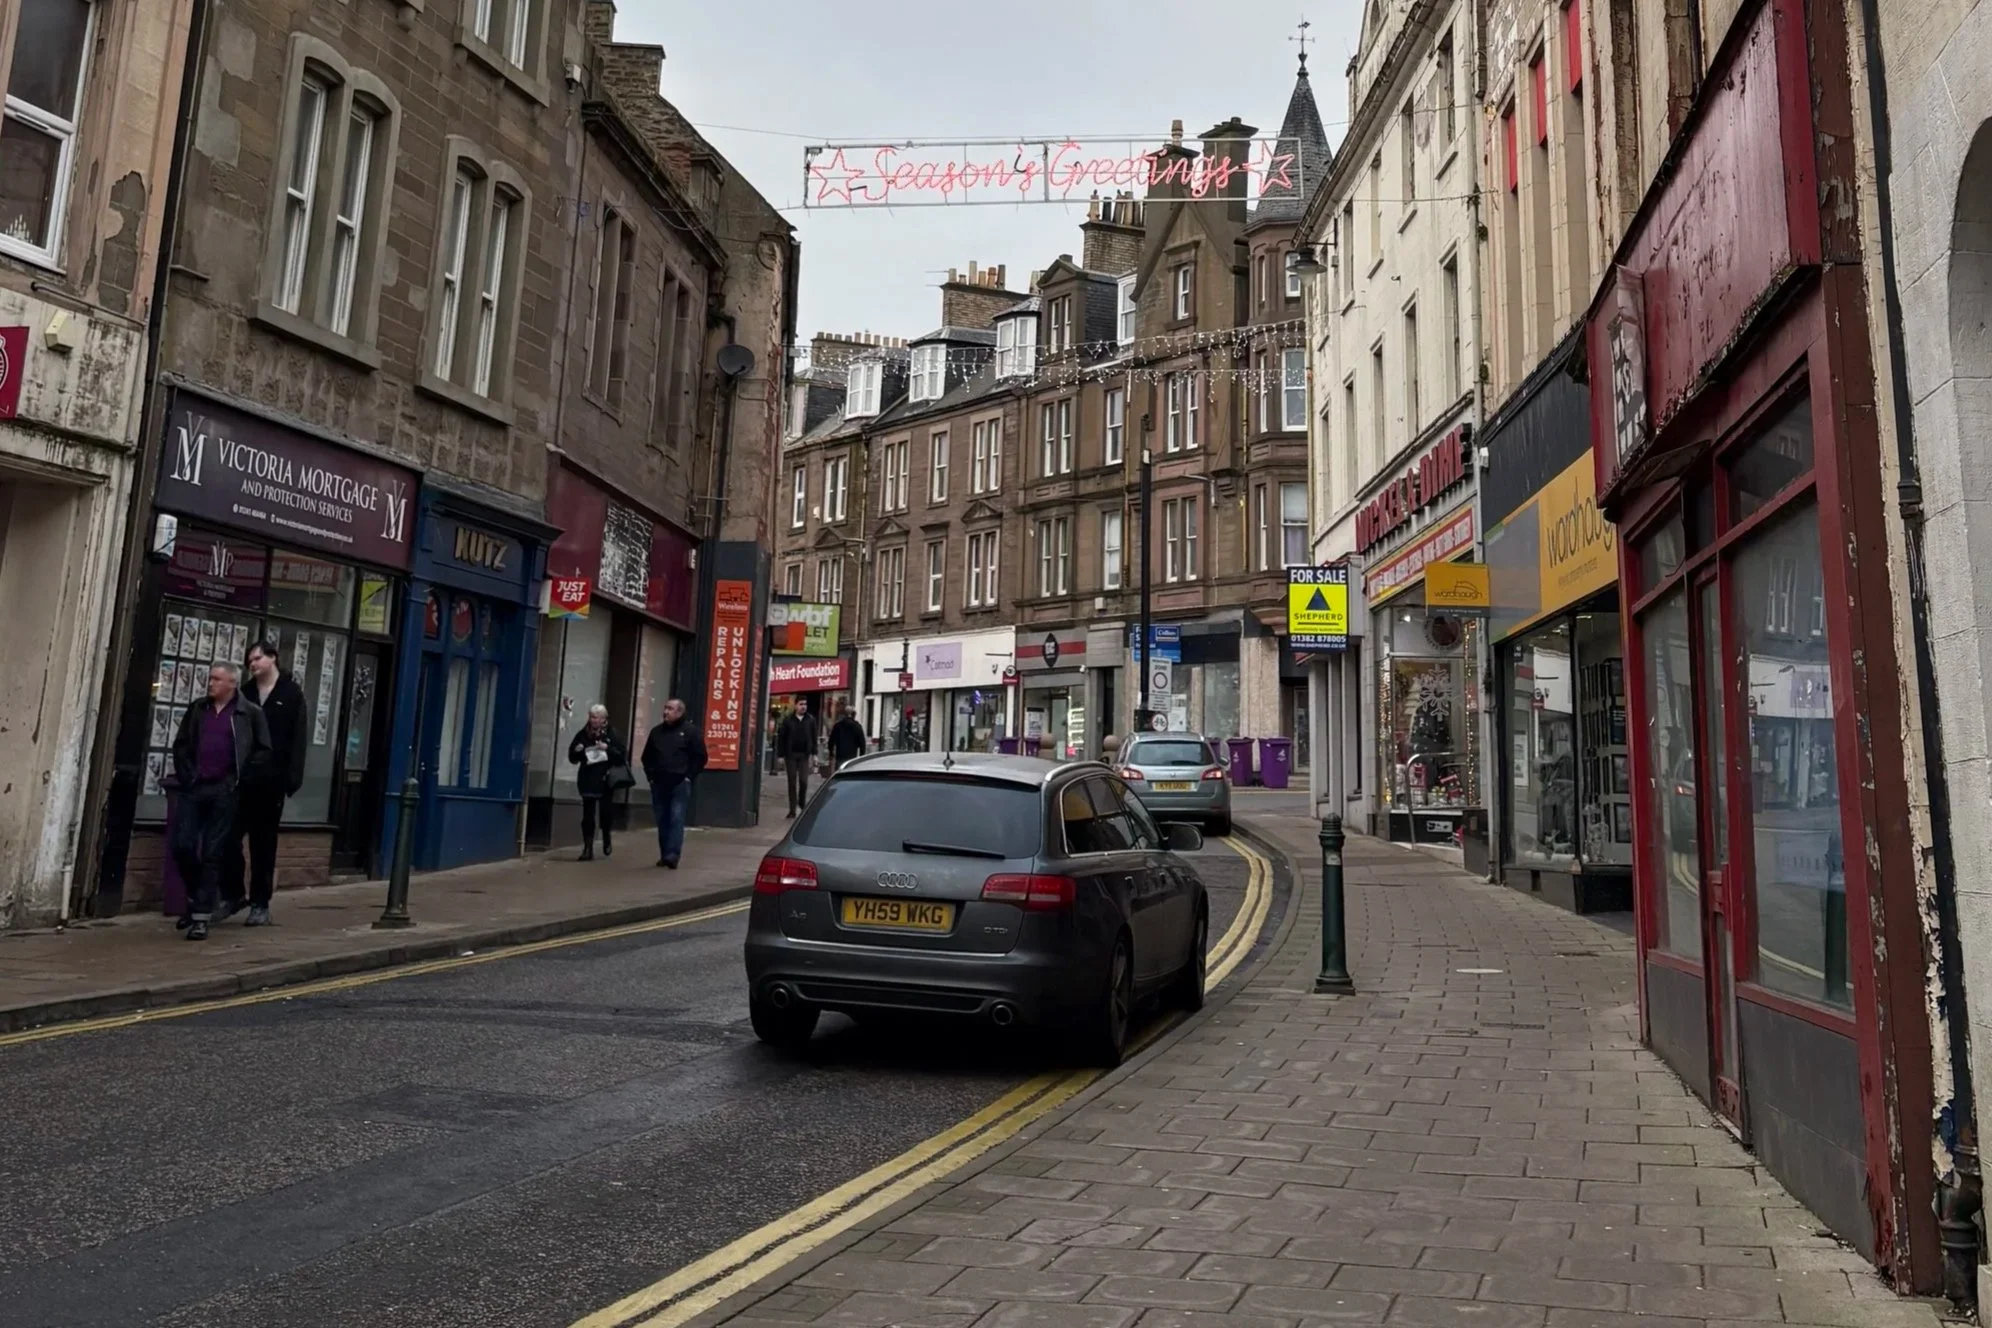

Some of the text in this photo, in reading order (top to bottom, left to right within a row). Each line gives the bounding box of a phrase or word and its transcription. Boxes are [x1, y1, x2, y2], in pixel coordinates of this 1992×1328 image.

[1049, 141, 1240, 198] Greetings
[219, 437, 379, 511] VICTORIA MORTGAGE
[241, 479, 262, 497] AND
[263, 485, 317, 513] PROTECTION
[318, 500, 353, 523] SERVICES
[557, 581, 586, 592] JUST
[1290, 569, 1346, 584] FOR SALE
[562, 592, 585, 602] EAT
[1294, 612, 1343, 621] SHEPHERD
[711, 626, 729, 720] REPAIRS &
[726, 626, 744, 720] UNLOCKING
[775, 667, 796, 680] Heart
[797, 661, 840, 678] Foundation
[853, 901, 944, 923] YH59 WKG
